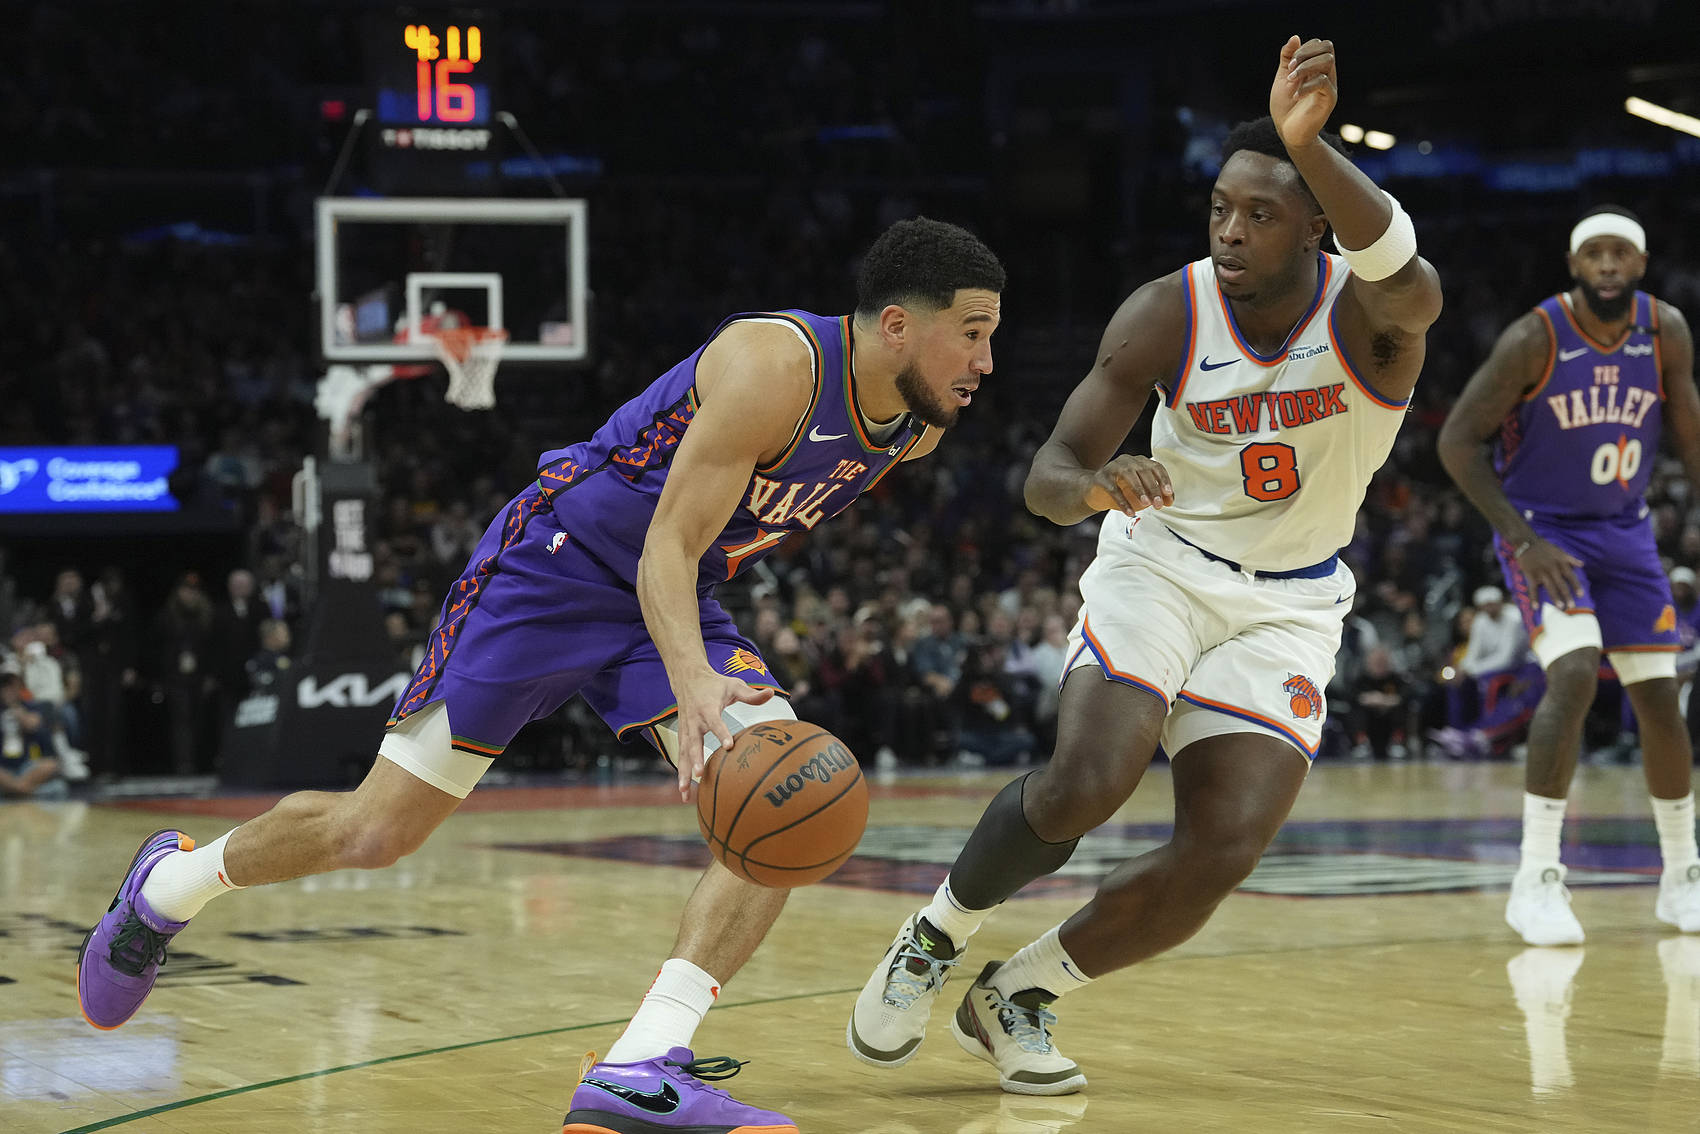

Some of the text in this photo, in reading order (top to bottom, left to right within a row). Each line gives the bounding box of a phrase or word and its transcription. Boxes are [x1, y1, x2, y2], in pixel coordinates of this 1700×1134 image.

[404, 24, 481, 63] 4:11
[417, 59, 475, 122] 16
[1186, 382, 1349, 435] NEW YORK
[1547, 385, 1657, 429] VALLEY
[1239, 442, 1301, 502] 8
[1590, 438, 1642, 485] 00
[763, 741, 856, 808] Wilson
